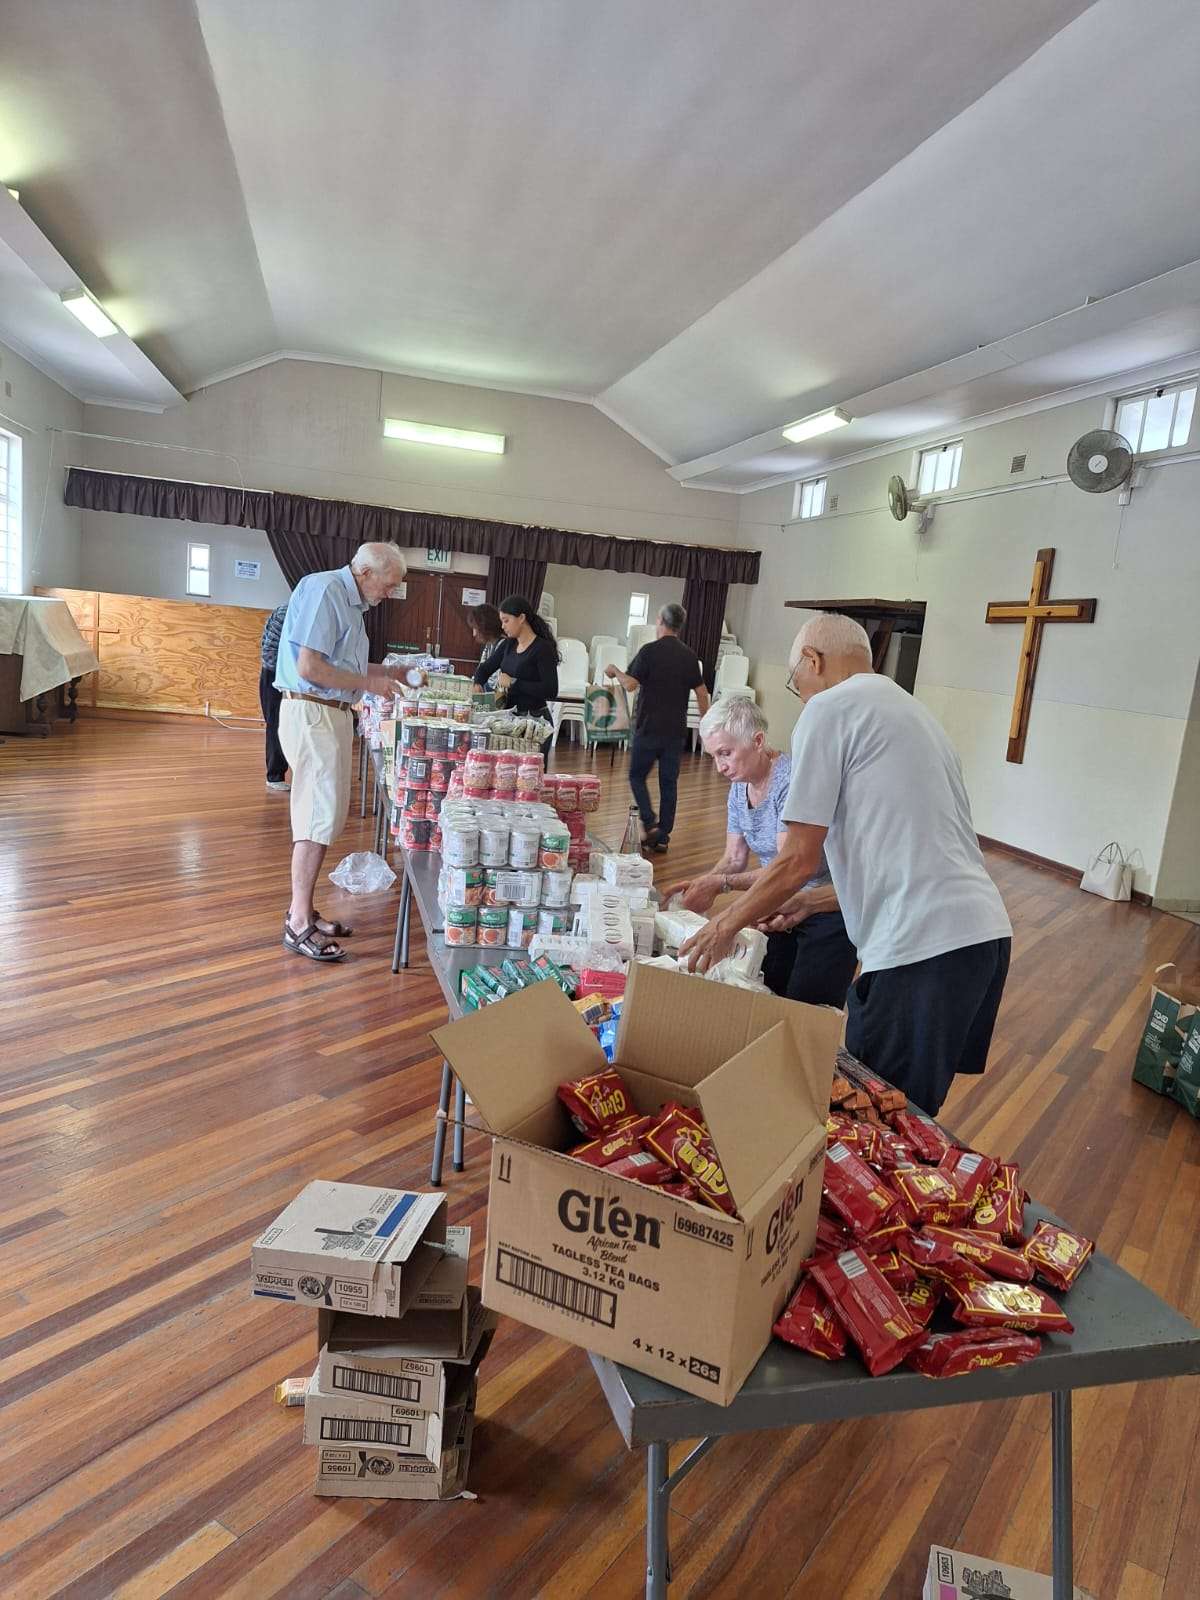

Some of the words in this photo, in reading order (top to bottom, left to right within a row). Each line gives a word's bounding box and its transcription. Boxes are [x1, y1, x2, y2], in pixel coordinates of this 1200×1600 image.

[427, 546, 448, 562] EXIT
[586, 1235, 620, 1252] African
[620, 1240, 637, 1252] Tea
[677, 1217, 734, 1247] 69687425
[552, 1243, 600, 1269] TAGLESS
[604, 1263, 625, 1278] TEA
[628, 1272, 660, 1292] BAGS
[600, 1249, 628, 1263] Blend
[582, 1267, 606, 1283] 3.12
[609, 1277, 625, 1290] KG
[632, 1337, 641, 1349] 4
[645, 1344, 653, 1354] x
[658, 1347, 675, 1362] 12
[678, 1358, 687, 1369] x
